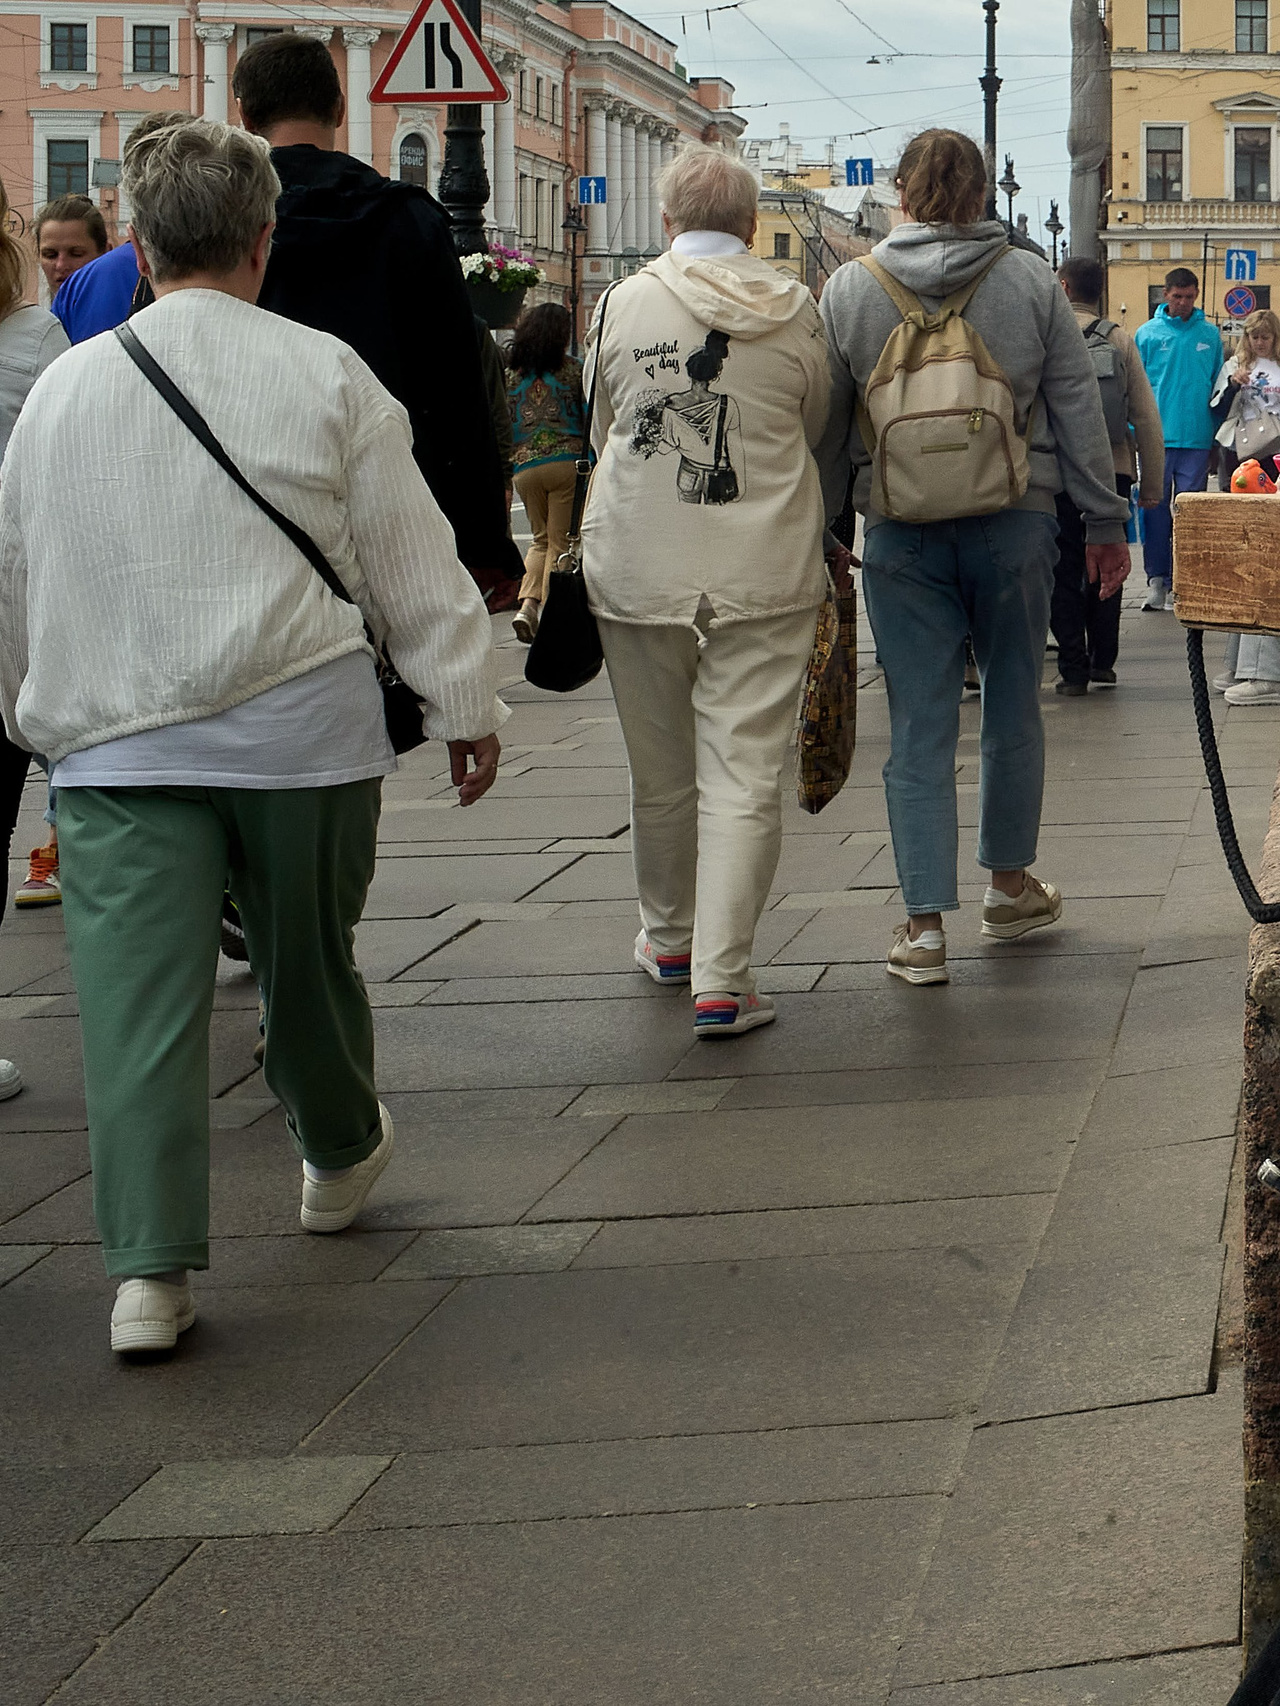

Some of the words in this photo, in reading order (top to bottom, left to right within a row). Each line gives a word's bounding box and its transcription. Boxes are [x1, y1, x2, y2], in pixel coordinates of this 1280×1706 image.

[401, 155, 424, 166] ОФИС
[633, 340, 679, 362] Beautiful
[659, 355, 679, 374] day
